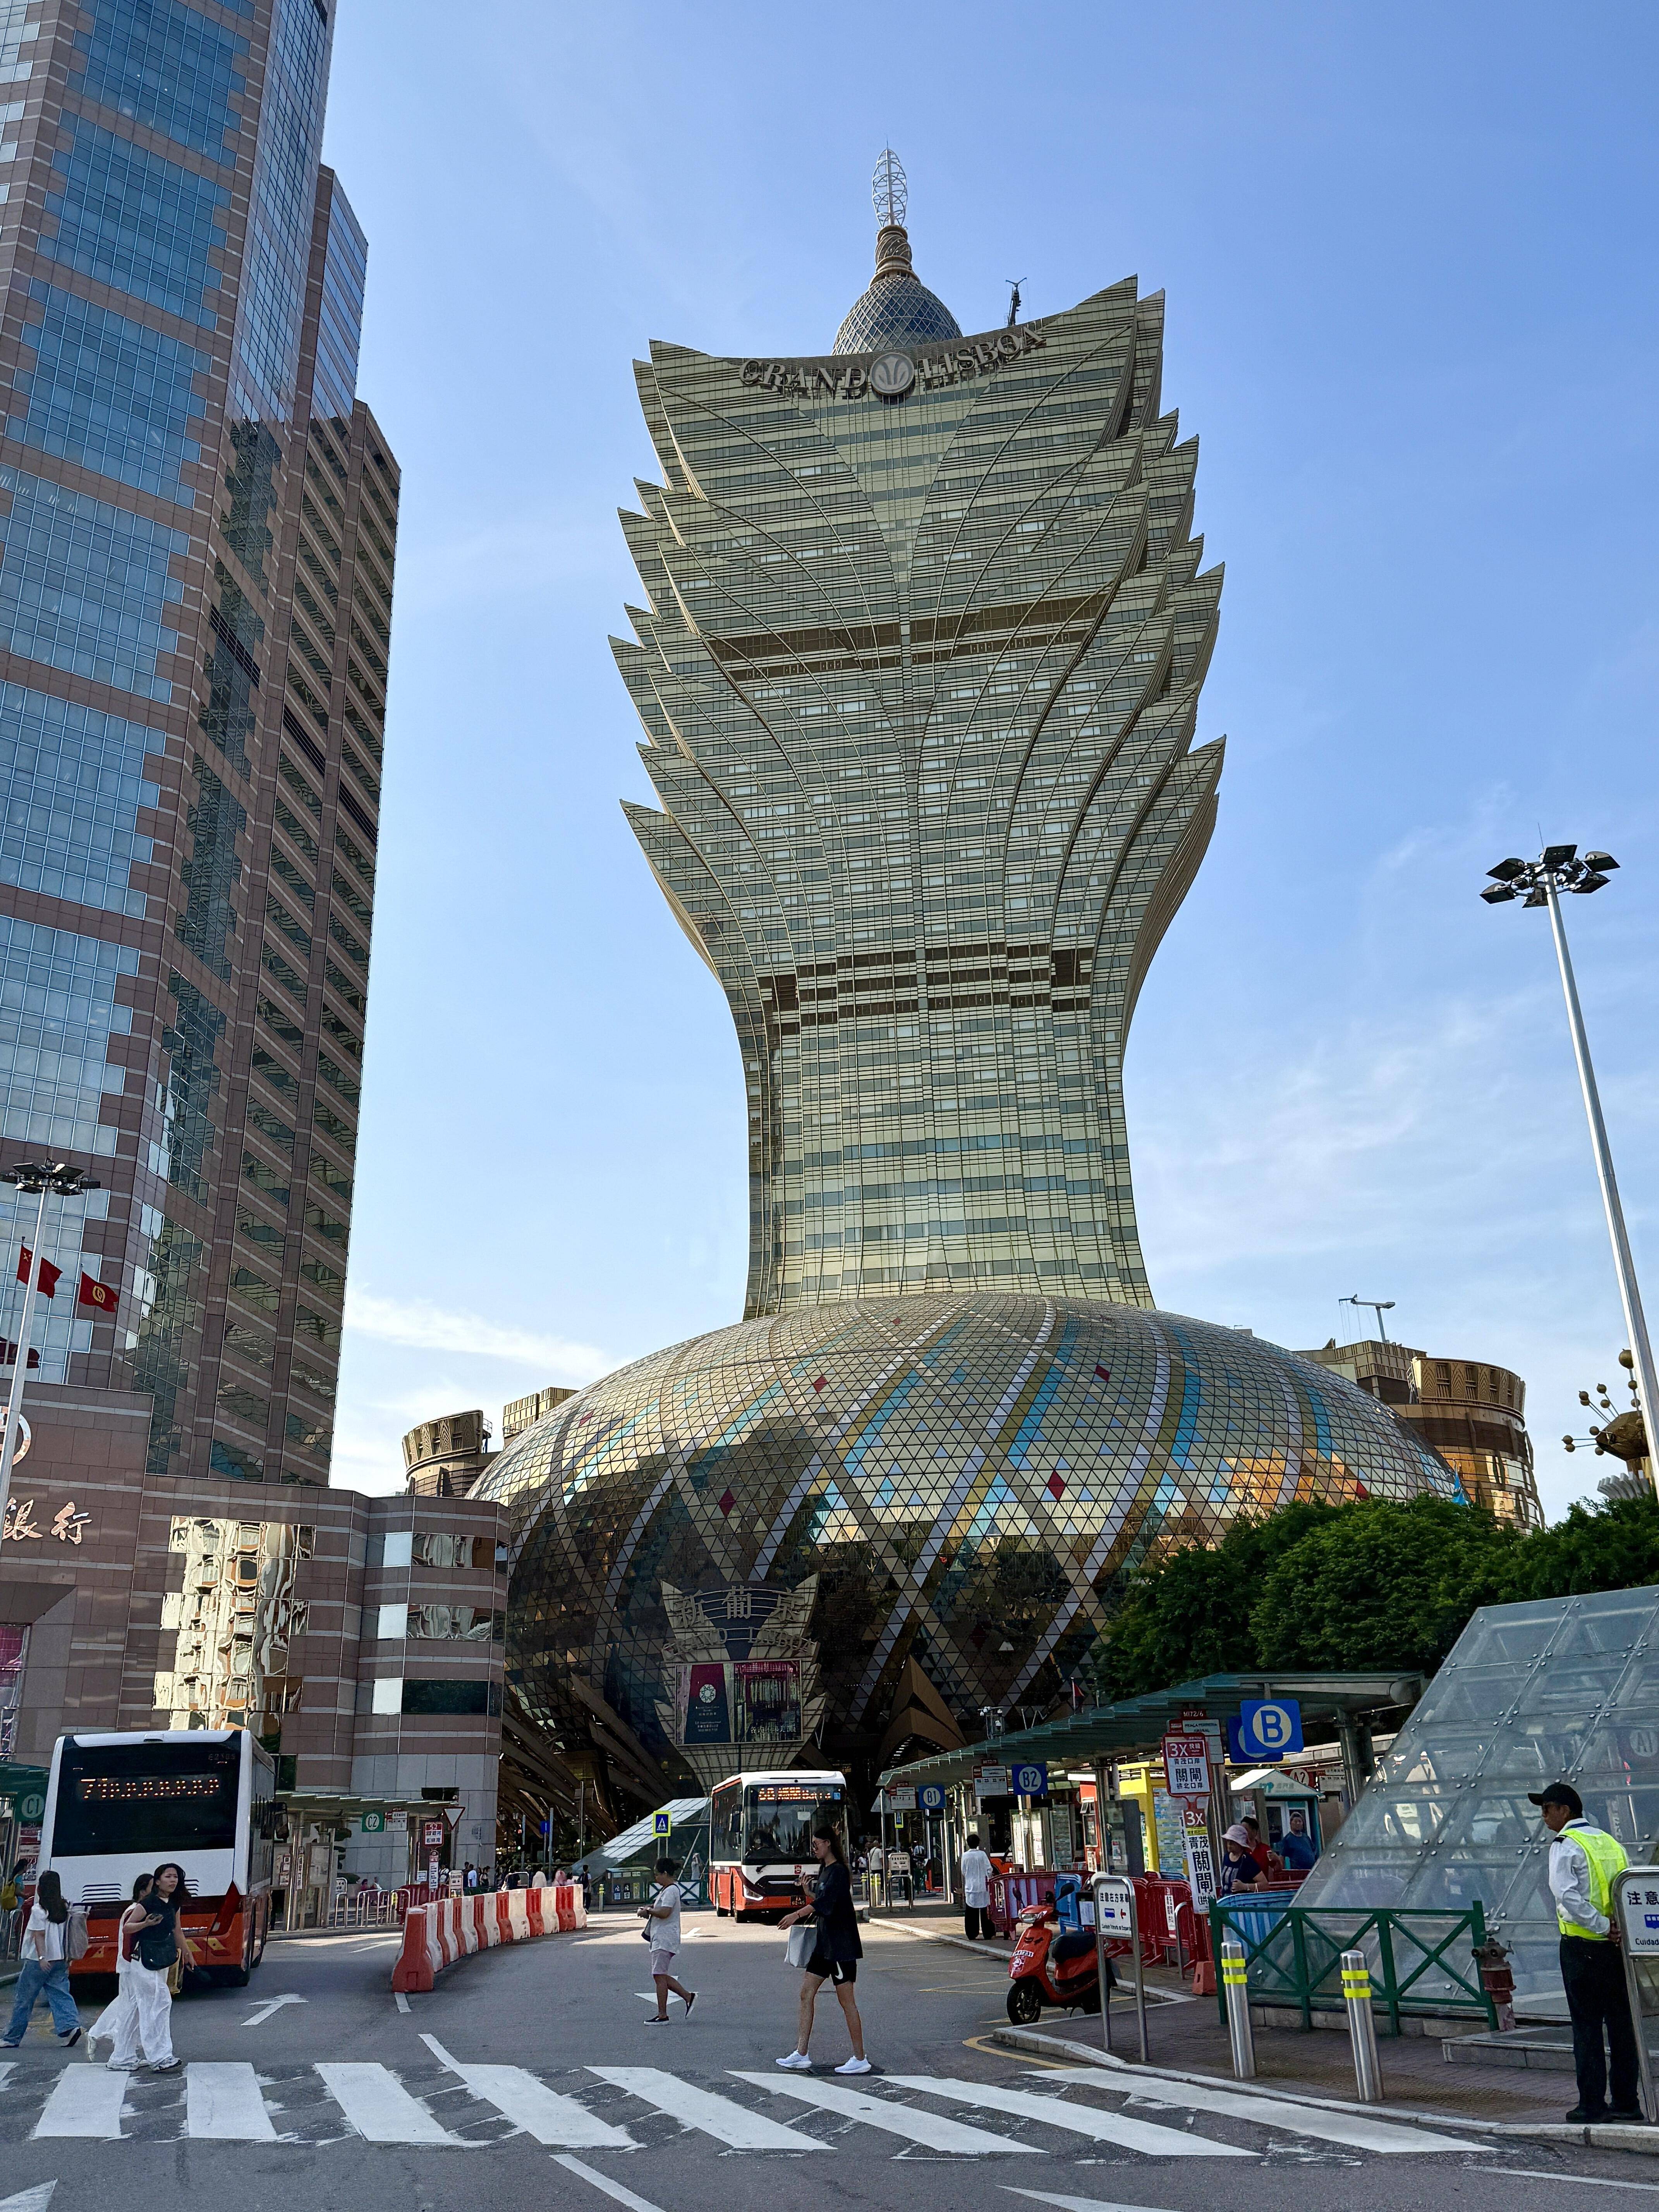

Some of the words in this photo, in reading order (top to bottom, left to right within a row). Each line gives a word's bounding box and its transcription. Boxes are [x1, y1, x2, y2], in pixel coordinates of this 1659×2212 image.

[739, 359, 866, 391] GRAND
[919, 326, 1046, 383] LISBOA
[674, 1585, 805, 1628] 新葡京
[662, 1628, 728, 1660] GRAND
[748, 1626, 813, 1657] LISBOA
[1261, 1710, 1283, 1743] B
[1170, 1743, 1188, 1757] 3X
[1023, 1771, 1038, 1788] B2
[1175, 1767, 1202, 1782] 關閘
[927, 1790, 936, 1803] B1
[27, 1798, 39, 1814] C1
[368, 1816, 377, 1827] C2
[1186, 1811, 1204, 1826] 3X
[1188, 1836, 1209, 1849] 青茂
[1192, 1850, 1213, 1894] 關閘
[1627, 1891, 1659, 1905] 注意
